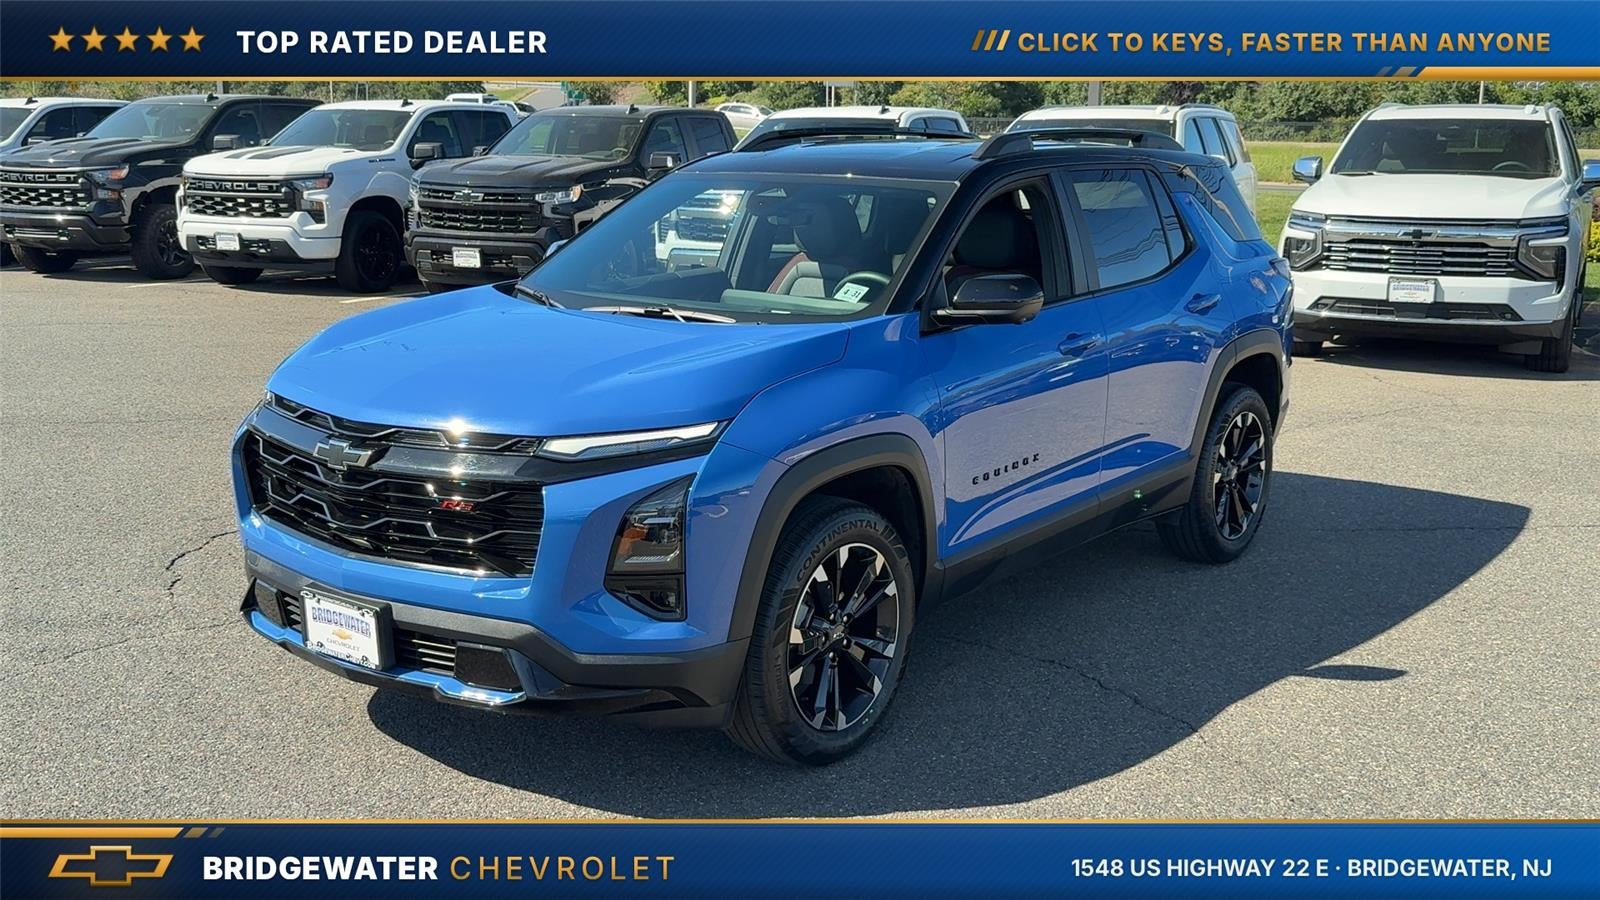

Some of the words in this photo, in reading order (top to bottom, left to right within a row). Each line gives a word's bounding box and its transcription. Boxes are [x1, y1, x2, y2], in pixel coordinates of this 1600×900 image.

[972, 453, 1040, 485] EQUINOX
[795, 518, 881, 583] CONTINENTAL
[311, 606, 372, 638] BRIDGEWATER
